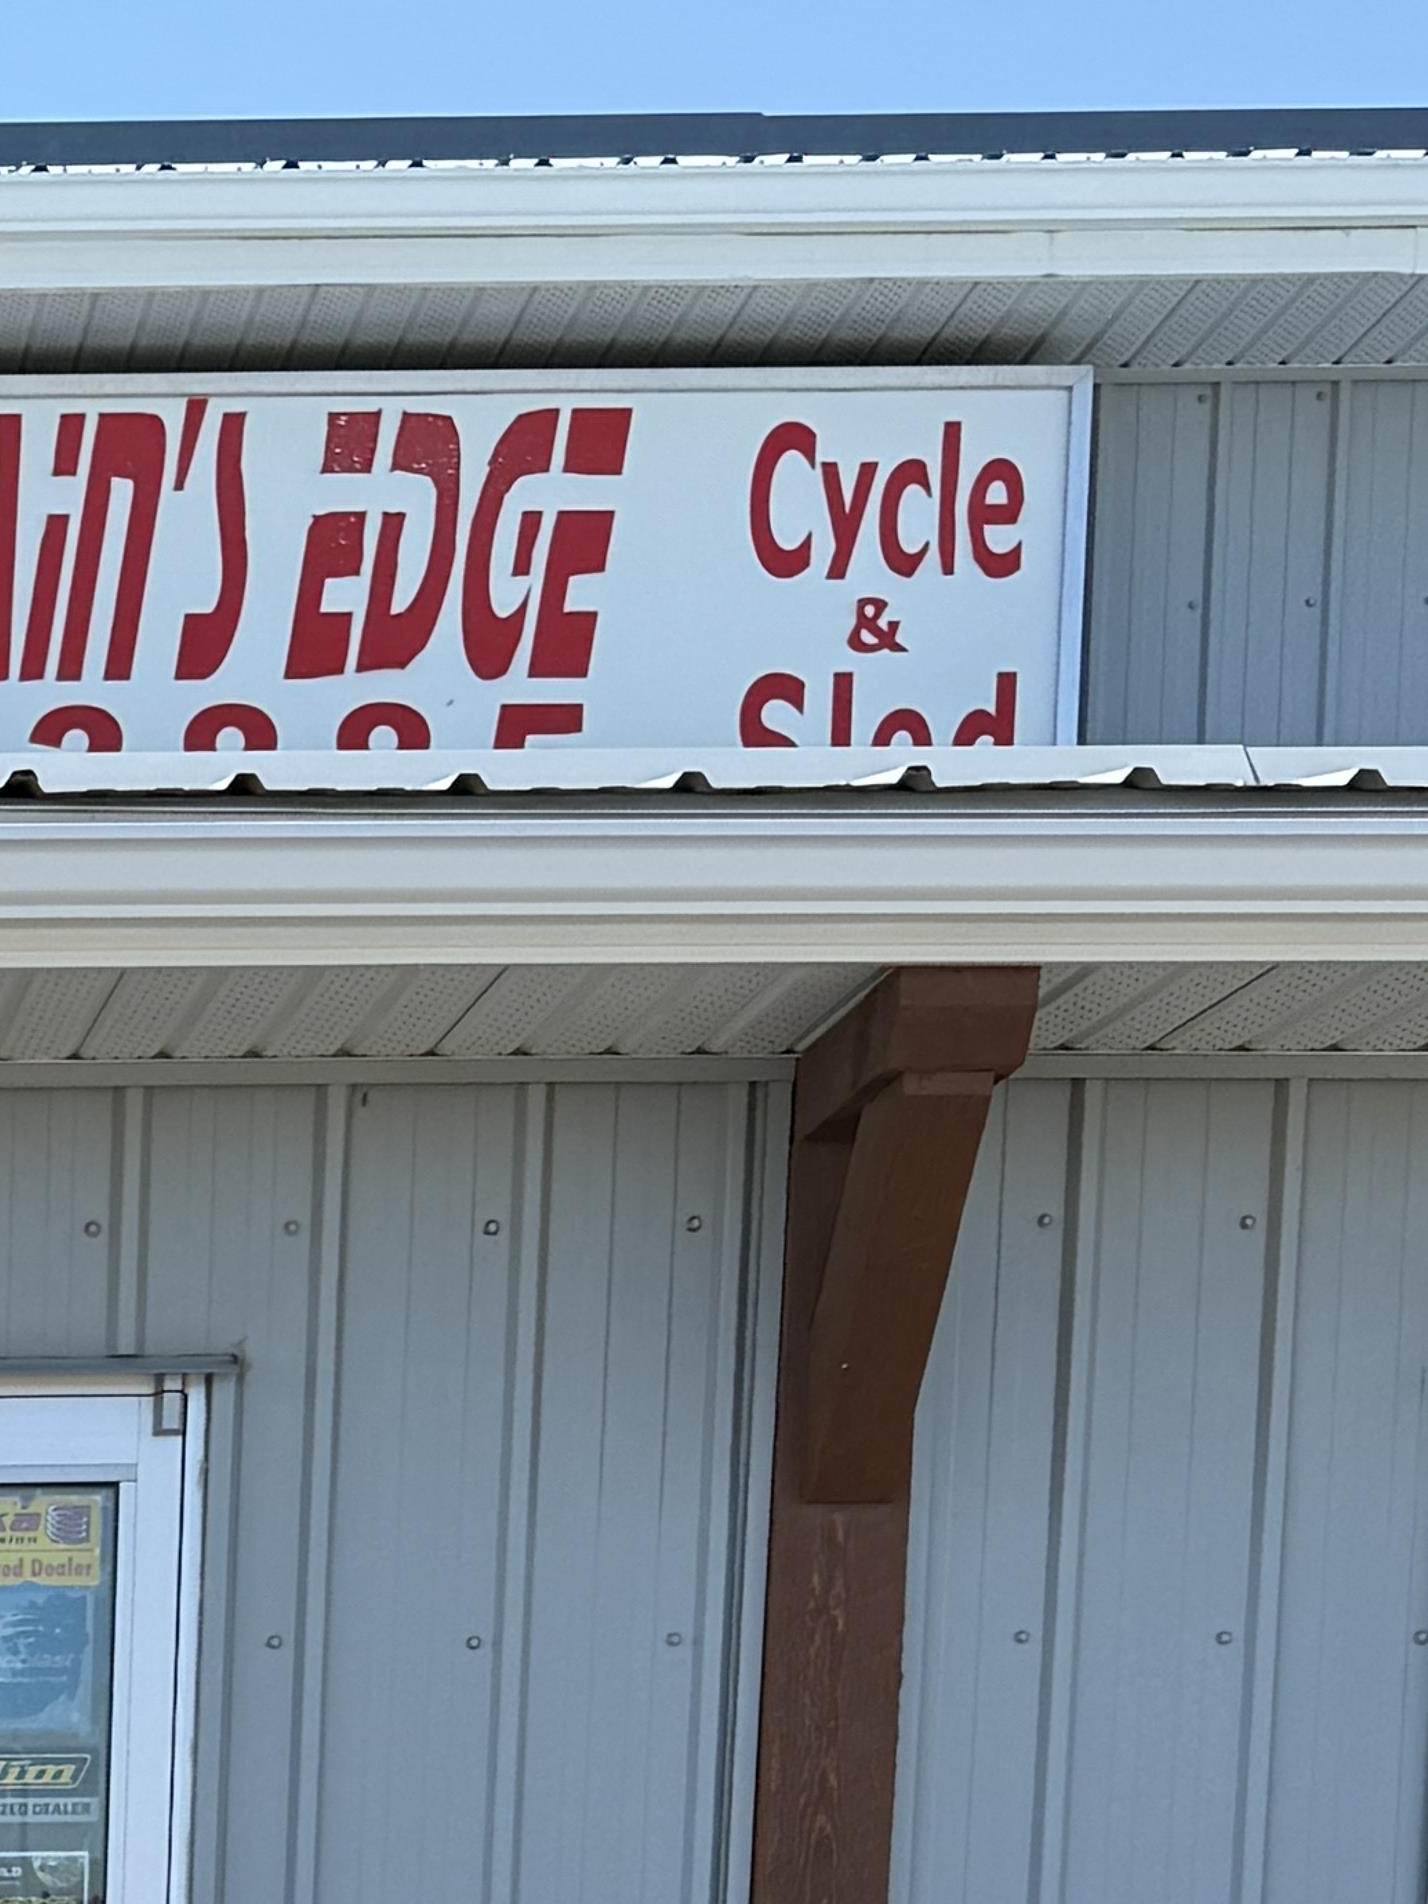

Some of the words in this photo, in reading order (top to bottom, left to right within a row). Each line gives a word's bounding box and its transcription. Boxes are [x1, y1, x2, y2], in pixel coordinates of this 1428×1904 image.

[284, 407, 633, 680] EDGE
[750, 421, 1025, 580] Cycle
[846, 597, 910, 654] &
[31, 1559, 91, 1578] Dealer
